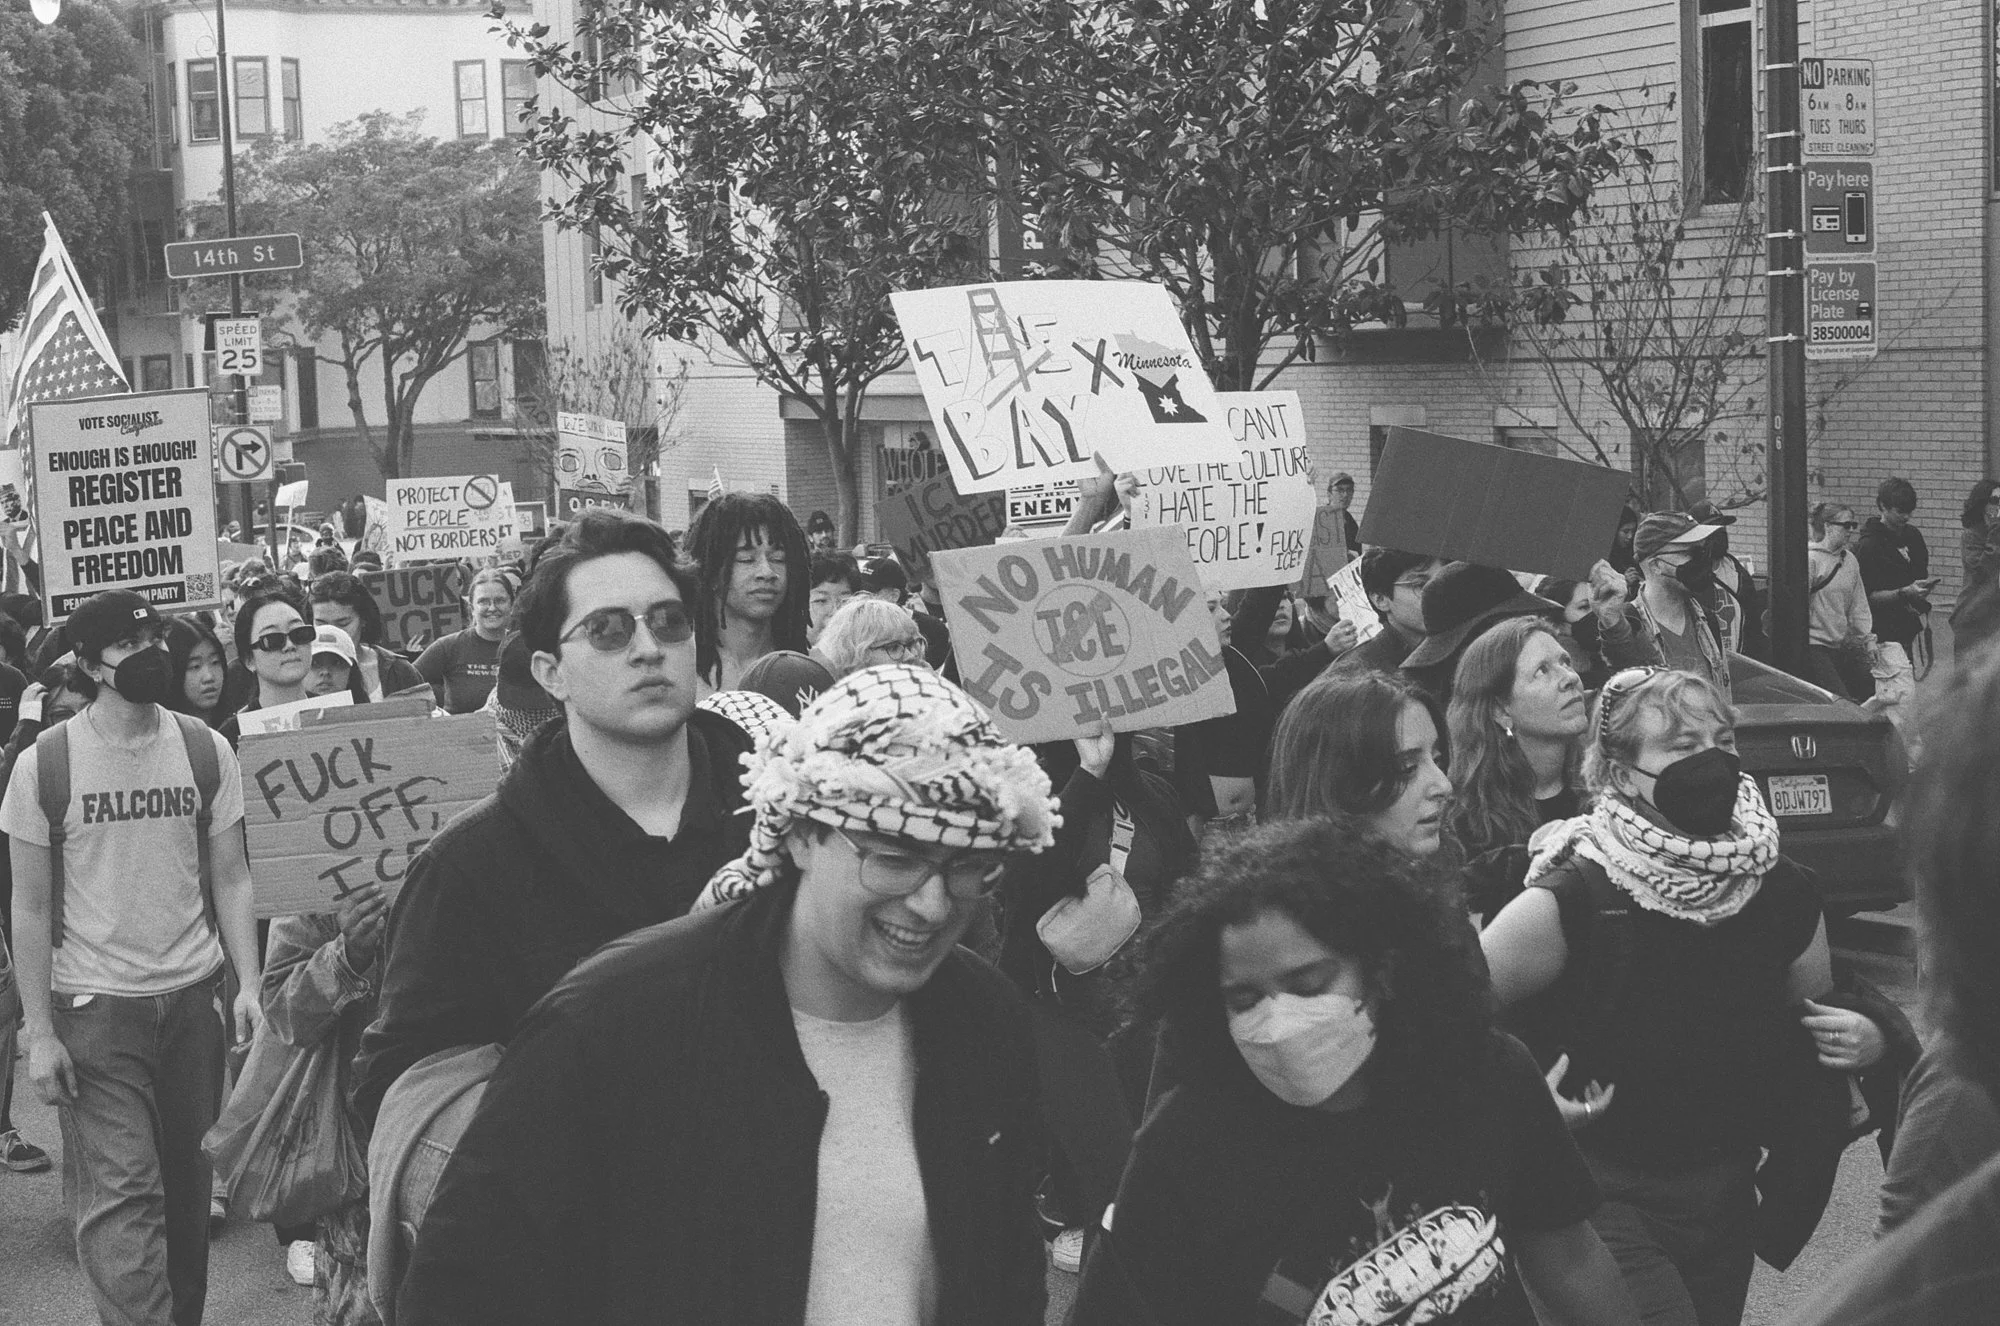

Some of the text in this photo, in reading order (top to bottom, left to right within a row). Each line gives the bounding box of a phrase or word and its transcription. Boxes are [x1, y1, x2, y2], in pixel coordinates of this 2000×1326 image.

[1803, 61, 1871, 86] NO PARKING
[1808, 93, 1829, 110] 6AM
[1845, 93, 1866, 110] 8AM
[1809, 119, 1866, 134] TUES THURS
[1808, 142, 1870, 152] STREET CLEANING
[1808, 169, 1869, 191] Pay here
[193, 245, 275, 267] 14th St
[1811, 267, 1856, 287] Pay by
[1811, 285, 1860, 301] License
[1811, 303, 1845, 319] Plate
[219, 325, 257, 335] SPEED
[224, 337, 253, 346] LIMIT
[1812, 325, 1870, 340] 38500004
[222, 349, 257, 369] 25
[1071, 338, 1125, 396] X
[1112, 351, 1192, 371] Minnesota
[79, 411, 159, 430] VOTE SOCIALIST
[1228, 404, 1289, 441] CANT
[943, 394, 1093, 480] BAY
[49, 440, 197, 472] ENOUGH IS ENOUGH!
[1135, 464, 1190, 487] OVE
[1239, 446, 1308, 480] CULTURE
[69, 467, 182, 507] REGISTER
[397, 487, 459, 506] PROTECT
[1010, 496, 1079, 517] ENEM
[1159, 485, 1215, 523] HATE
[1228, 481, 1268, 517] THE
[63, 507, 192, 550] PEACE AND
[407, 508, 470, 527] PEOPLE
[395, 528, 497, 552] NOT BORDERS
[1184, 522, 1264, 563] EOPLE!
[1271, 529, 1304, 555] FUCK
[71, 545, 184, 586] FREEDOM
[1275, 550, 1303, 570] ICE!
[63, 595, 90, 611] PEA
[151, 586, 178, 601] PARTY
[363, 567, 457, 607] FUCK
[959, 544, 1196, 634] NO HUMAN
[1036, 597, 1126, 665] ICE
[962, 637, 1225, 725] IS ILLEGAL
[255, 738, 392, 819] FUCK
[82, 787, 195, 824] FALCONS
[1774, 789, 1827, 811] 8DJW797
